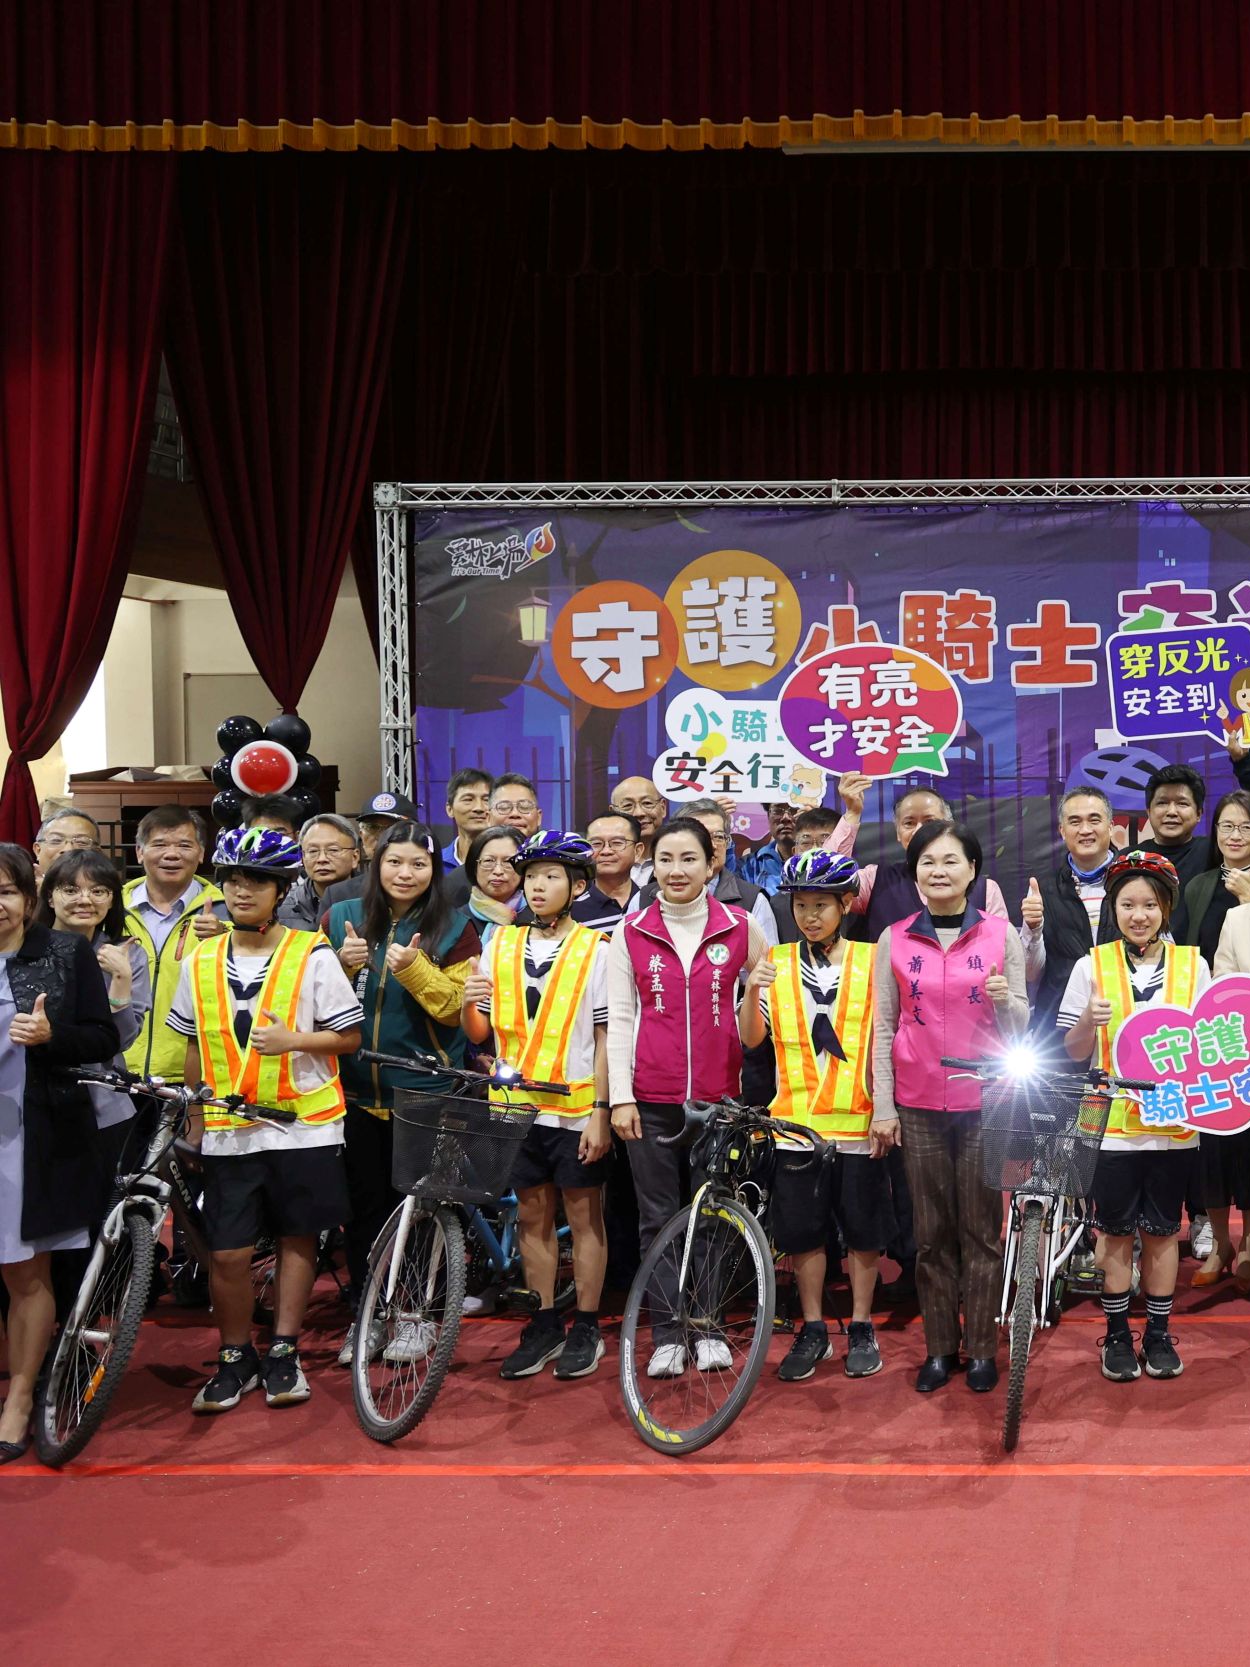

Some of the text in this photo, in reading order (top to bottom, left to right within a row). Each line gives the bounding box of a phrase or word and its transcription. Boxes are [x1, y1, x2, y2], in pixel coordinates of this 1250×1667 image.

[1119, 637, 1231, 680] 穿反光
[818, 660, 919, 710] 有亮
[1123, 681, 1216, 718] 安全到
[680, 702, 784, 743] 小騎
[808, 715, 935, 758] 才安全
[665, 751, 786, 793] 安全行
[647, 954, 667, 1014] 蔡孟真
[710, 968, 722, 1027] 雲林縣議員
[907, 955, 926, 1026] 蕭美文
[966, 956, 985, 1005] 鎮長
[1141, 1012, 1250, 1074] 守護
